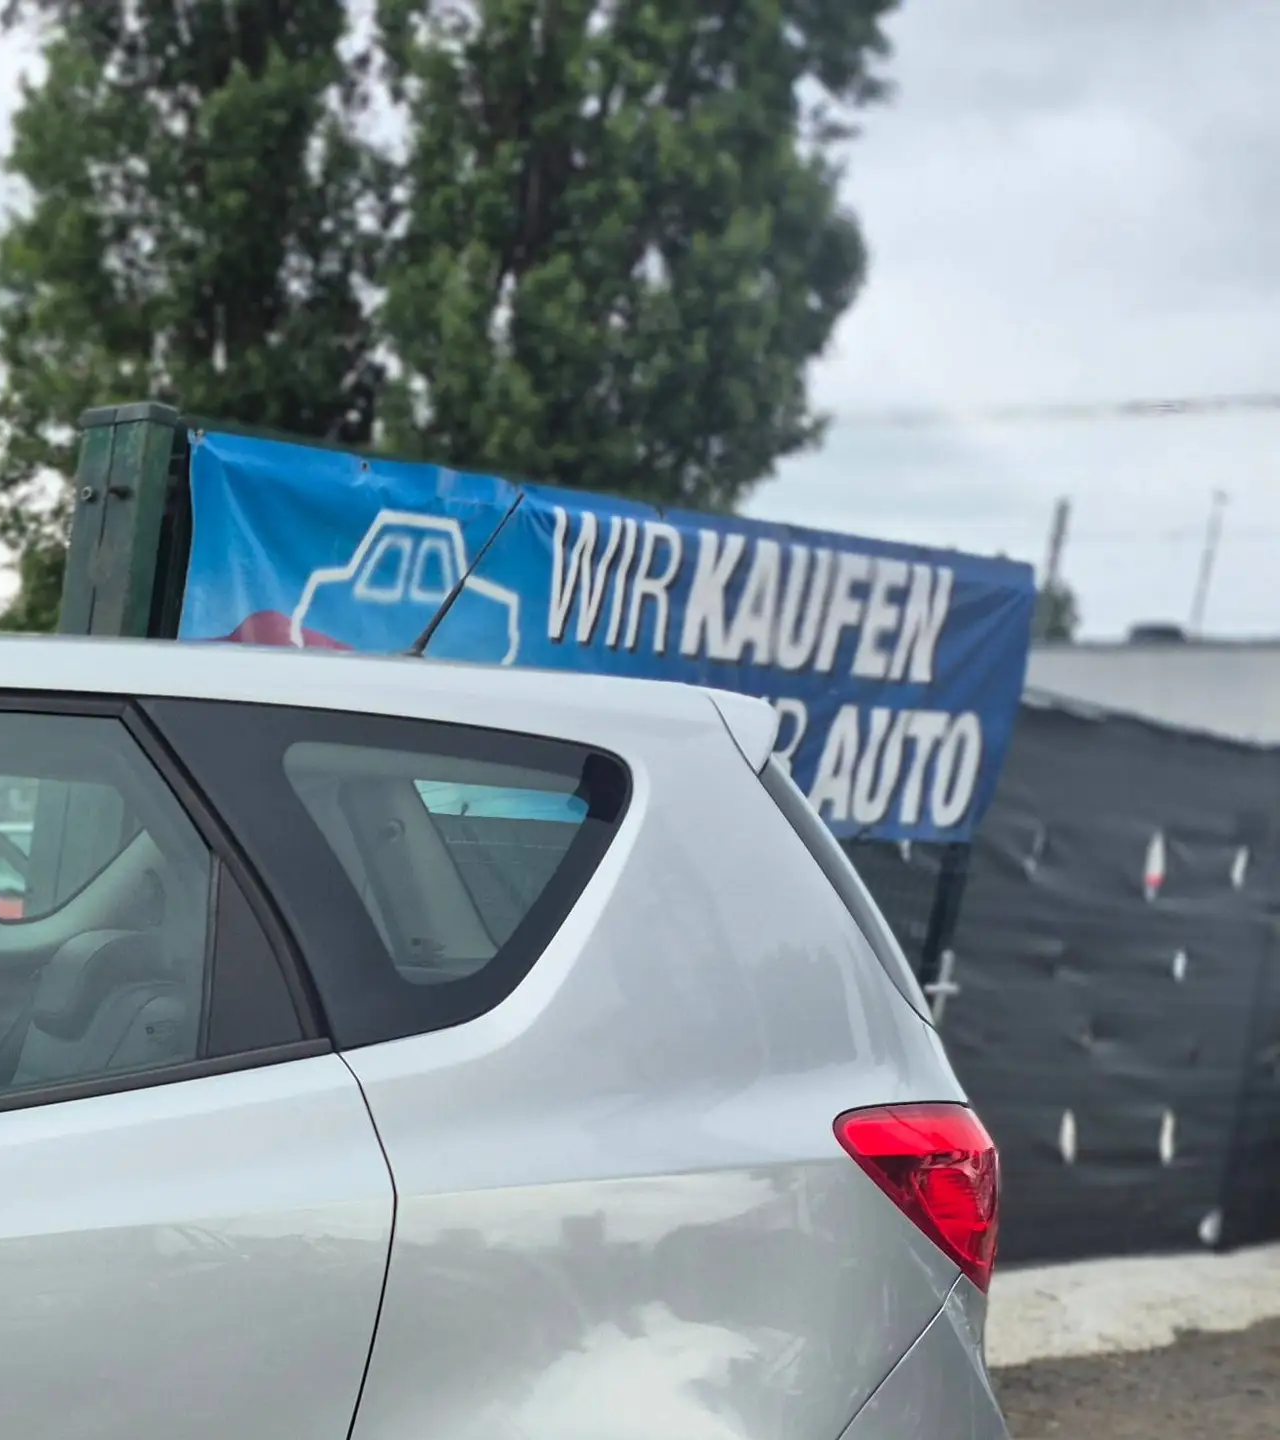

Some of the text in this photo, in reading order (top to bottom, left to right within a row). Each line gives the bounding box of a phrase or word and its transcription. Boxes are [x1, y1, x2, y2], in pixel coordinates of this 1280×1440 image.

[548, 506, 953, 684] WIR KAUFEN
[809, 705, 982, 828] AUTO
